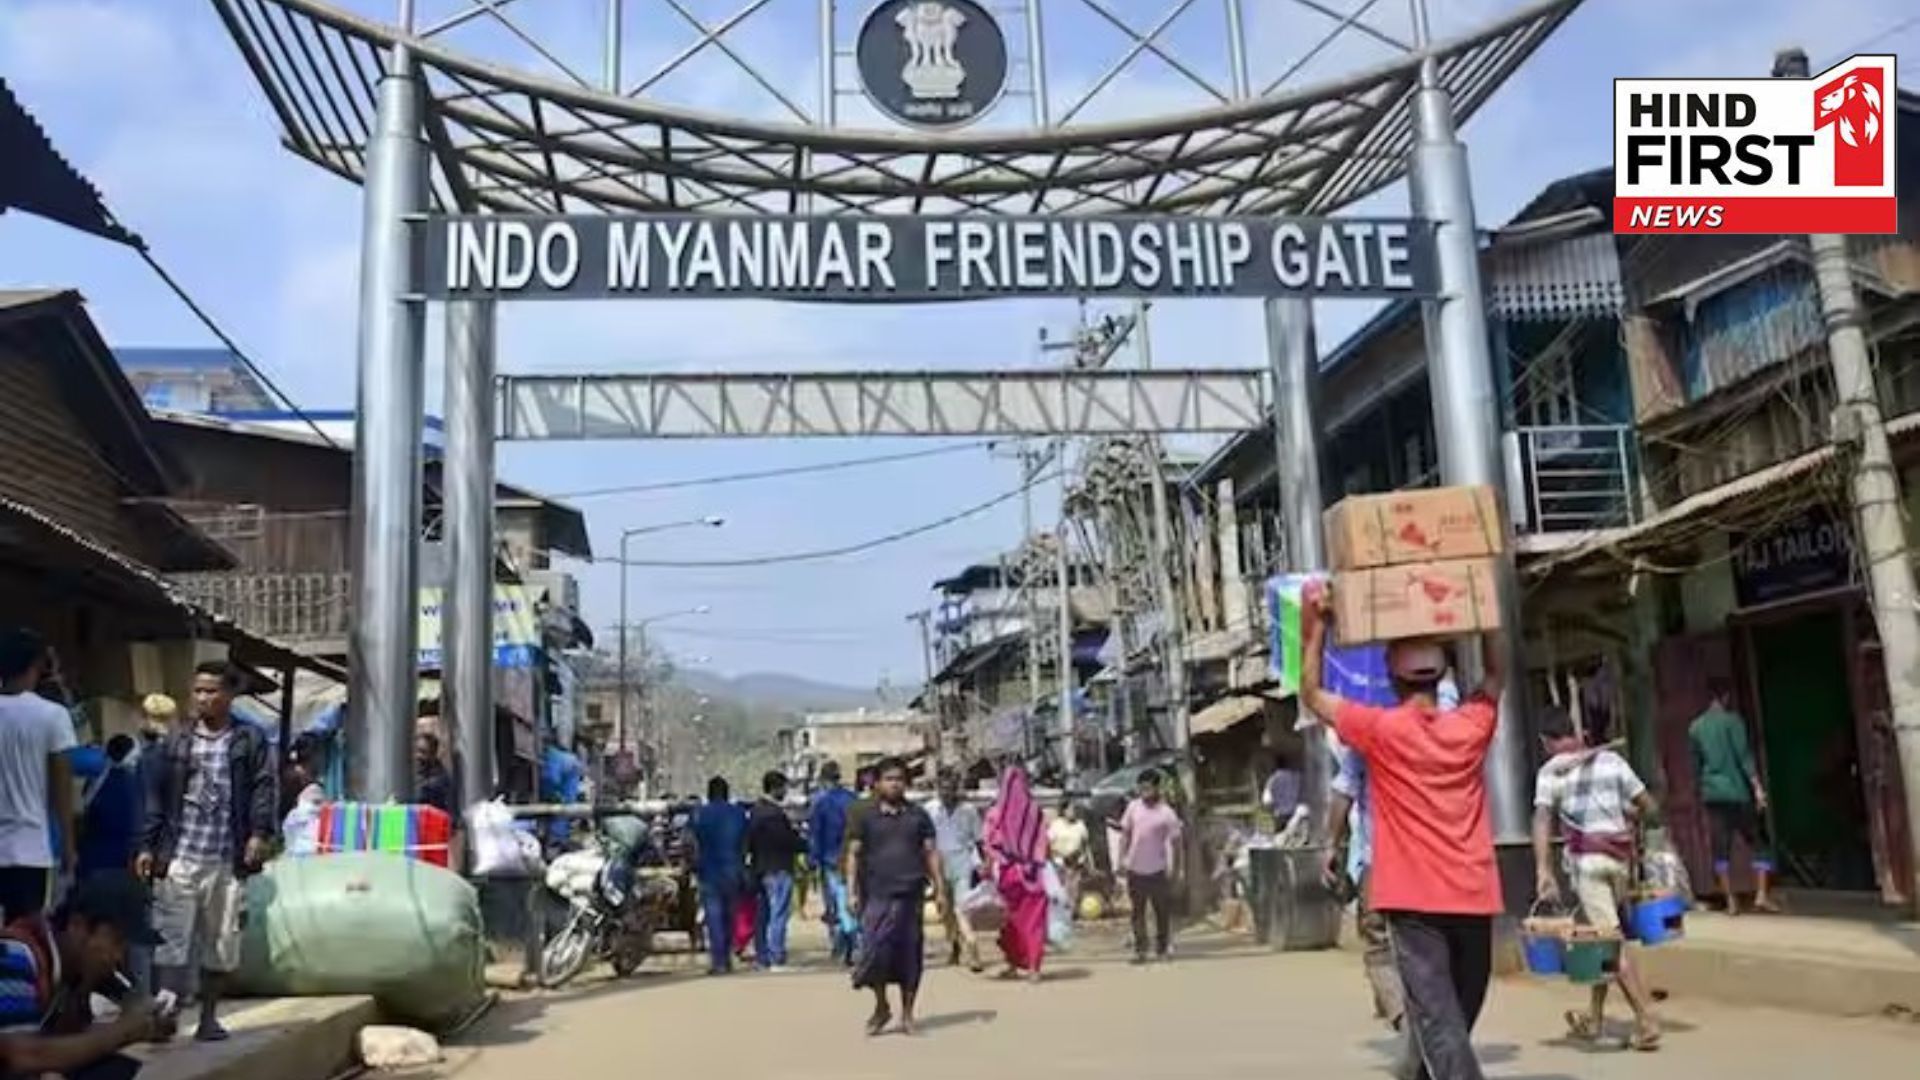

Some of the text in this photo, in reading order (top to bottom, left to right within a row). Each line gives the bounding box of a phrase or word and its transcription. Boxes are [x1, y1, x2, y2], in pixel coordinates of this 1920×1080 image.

[446, 221, 1413, 289] INDO MYANMAR FRIENDSHIP GATE
